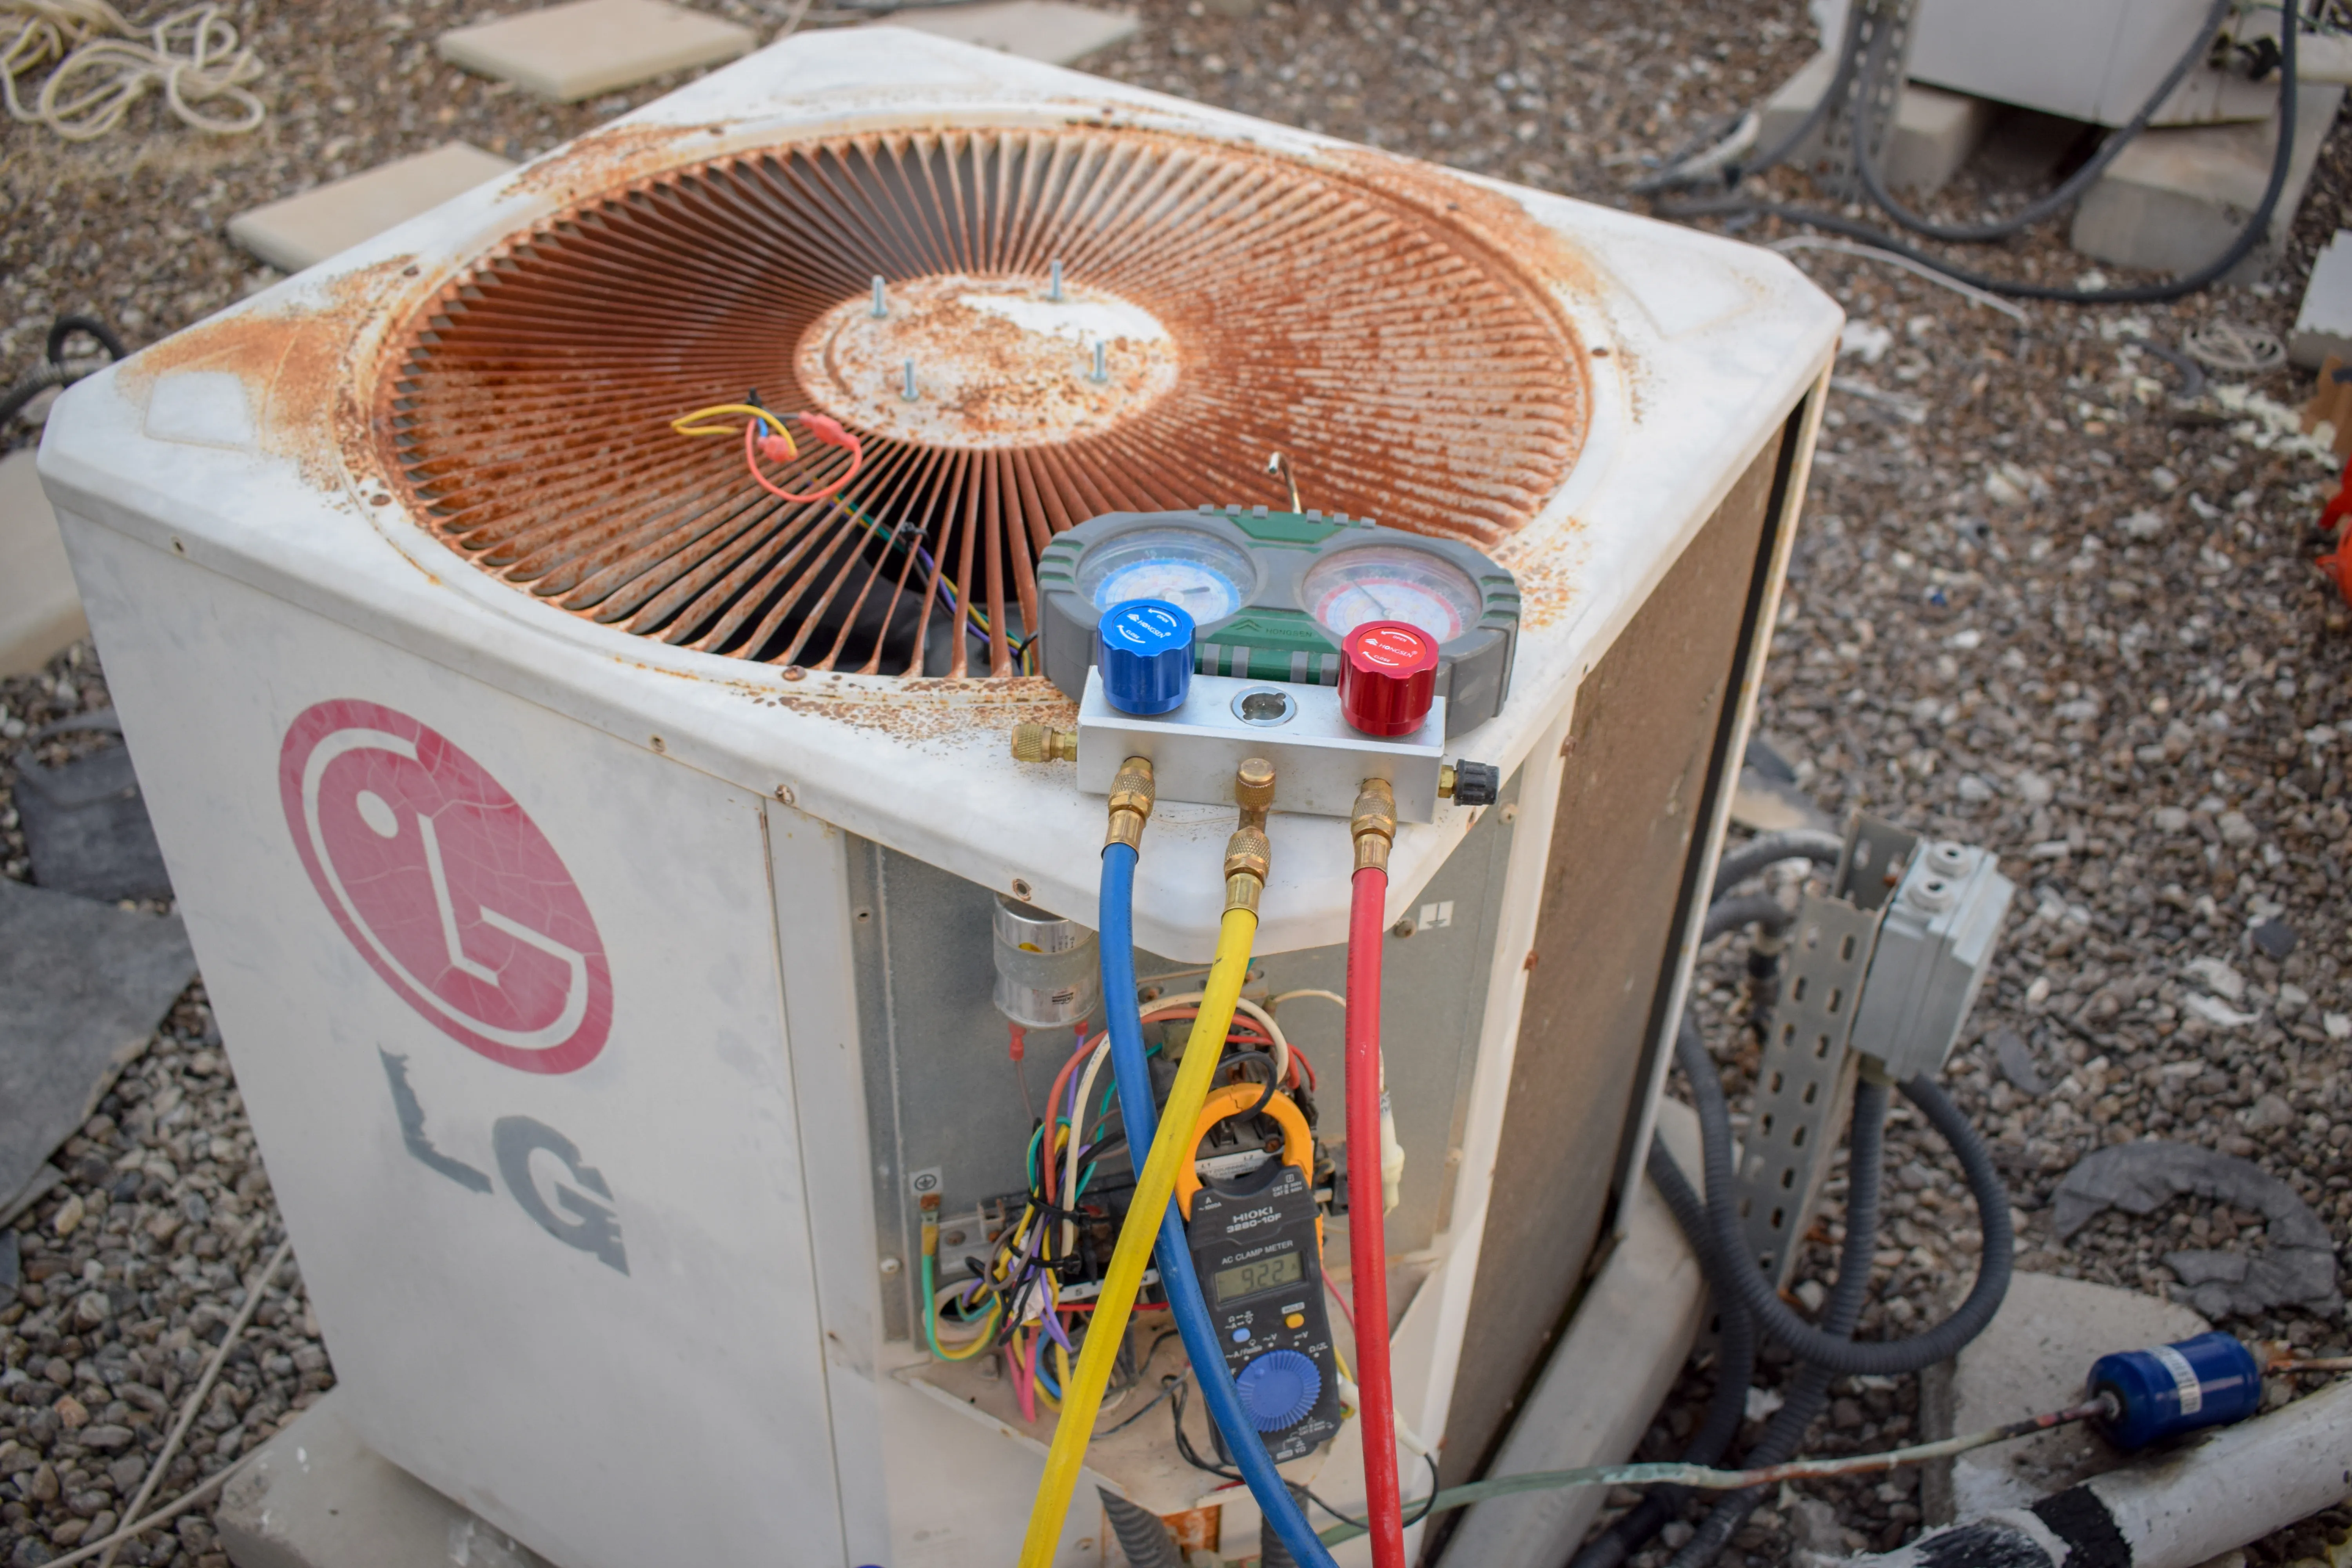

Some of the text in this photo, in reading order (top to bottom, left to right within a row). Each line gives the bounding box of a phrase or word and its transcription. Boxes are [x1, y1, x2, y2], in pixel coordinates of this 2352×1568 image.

[1157, 615, 1169, 623] OPEN
[1126, 630, 1140, 639] CLOSE
[1266, 628, 1312, 637] HONGSEN
[377, 1042, 630, 1278] LG
[1205, 1196, 1212, 1205] A
[1232, 1206, 1273, 1223] HIOKI
[1227, 1212, 1282, 1233] 3280-10F
[1221, 1240, 1294, 1265] AC CLAMP METER
